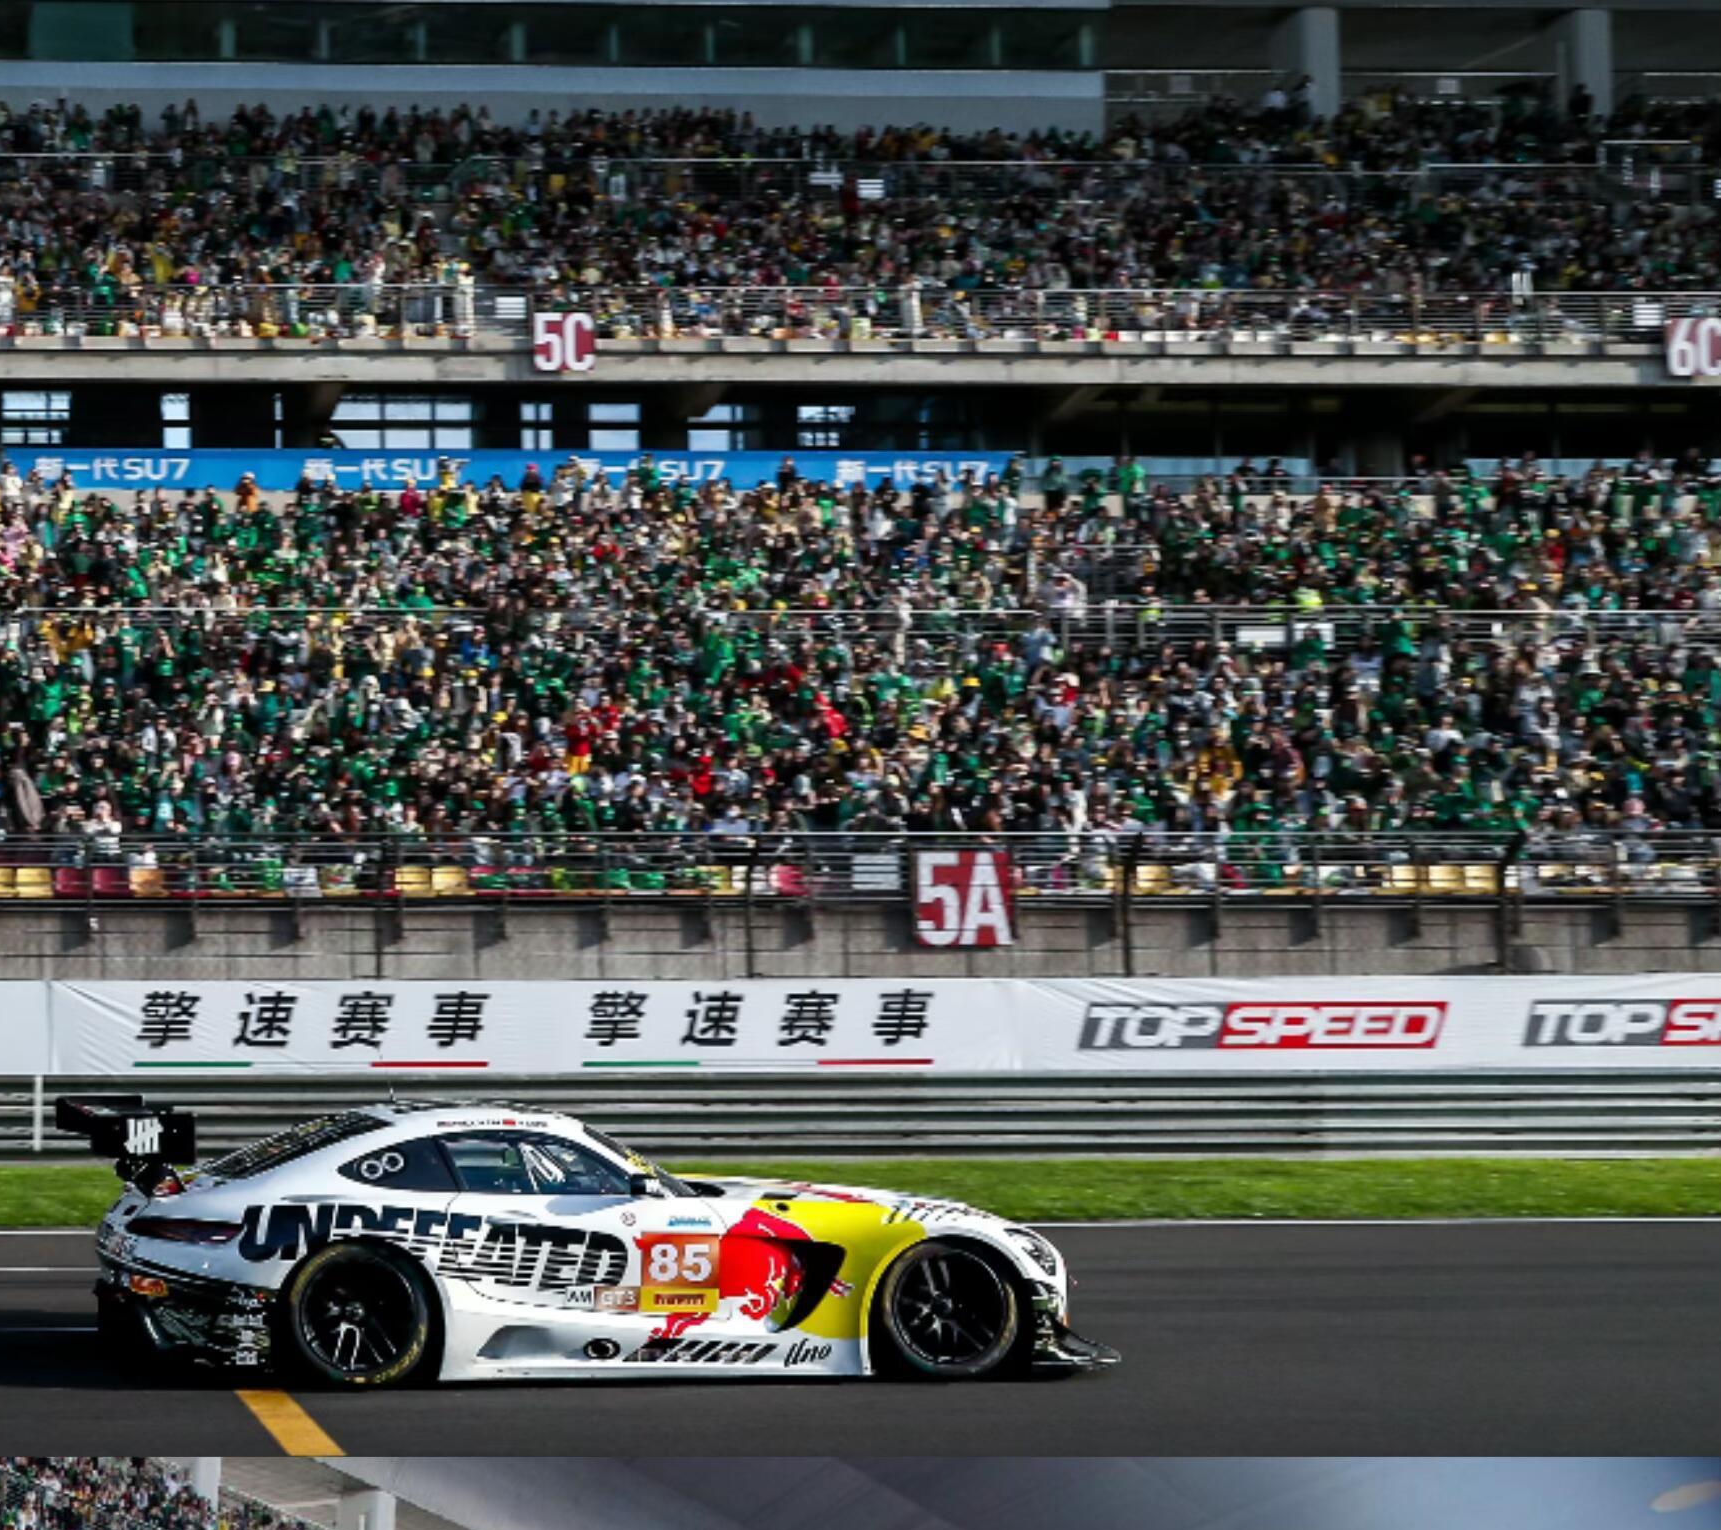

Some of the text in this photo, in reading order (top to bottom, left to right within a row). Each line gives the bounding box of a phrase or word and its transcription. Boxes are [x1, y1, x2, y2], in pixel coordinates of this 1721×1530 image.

[533, 312, 595, 371] 5C
[1669, 318, 1721, 376] 6C
[916, 851, 1013, 946] 5A
[136, 991, 491, 1047] 擎速赛事
[584, 989, 934, 1046] 擎速赛事
[1088, 1004, 1442, 1047] TOP SPEED
[1532, 1003, 1665, 1045] TOP
[648, 1243, 712, 1282] 85
[567, 1288, 592, 1304] AM
